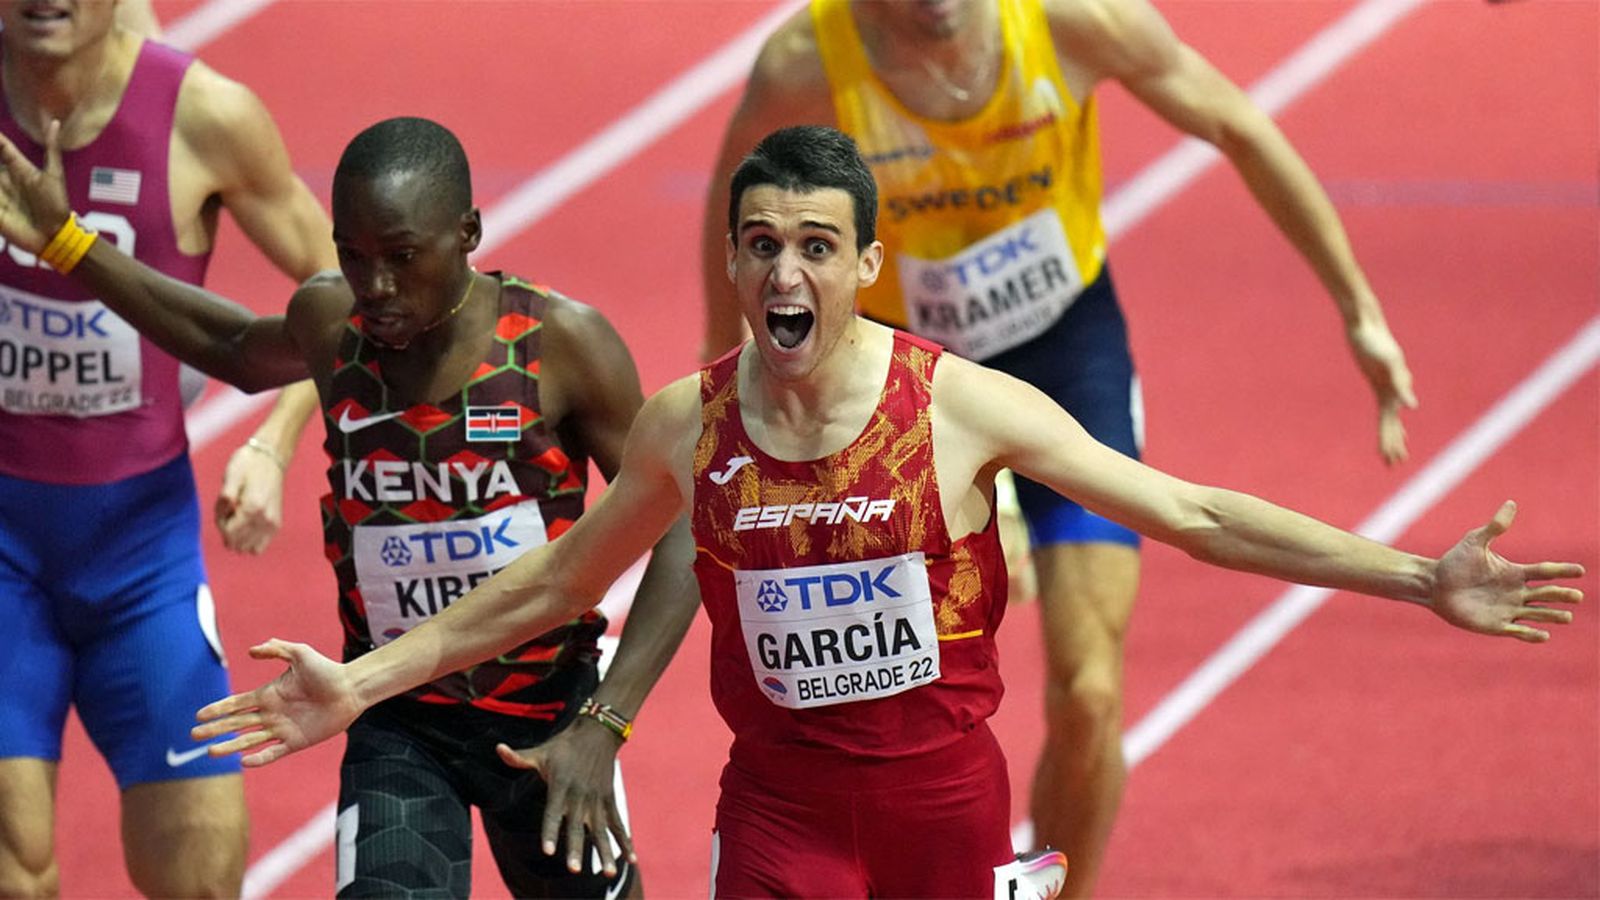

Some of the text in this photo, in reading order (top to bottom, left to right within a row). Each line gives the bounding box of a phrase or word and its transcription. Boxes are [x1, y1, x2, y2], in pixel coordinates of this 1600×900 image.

[886, 166, 1053, 219] SWEDEN
[953, 226, 1038, 286] TDK
[914, 255, 1069, 330] KRAMER
[11, 300, 110, 339] TDK
[0, 340, 124, 385] OPPEL
[343, 459, 522, 502] KENYA
[733, 496, 897, 532] ESPAÑA
[410, 516, 520, 564] TDK
[394, 566, 506, 618] KIB
[785, 564, 902, 610] TDK
[756, 612, 922, 671] GARCÍA
[797, 656, 934, 701] BELGRADE 22
